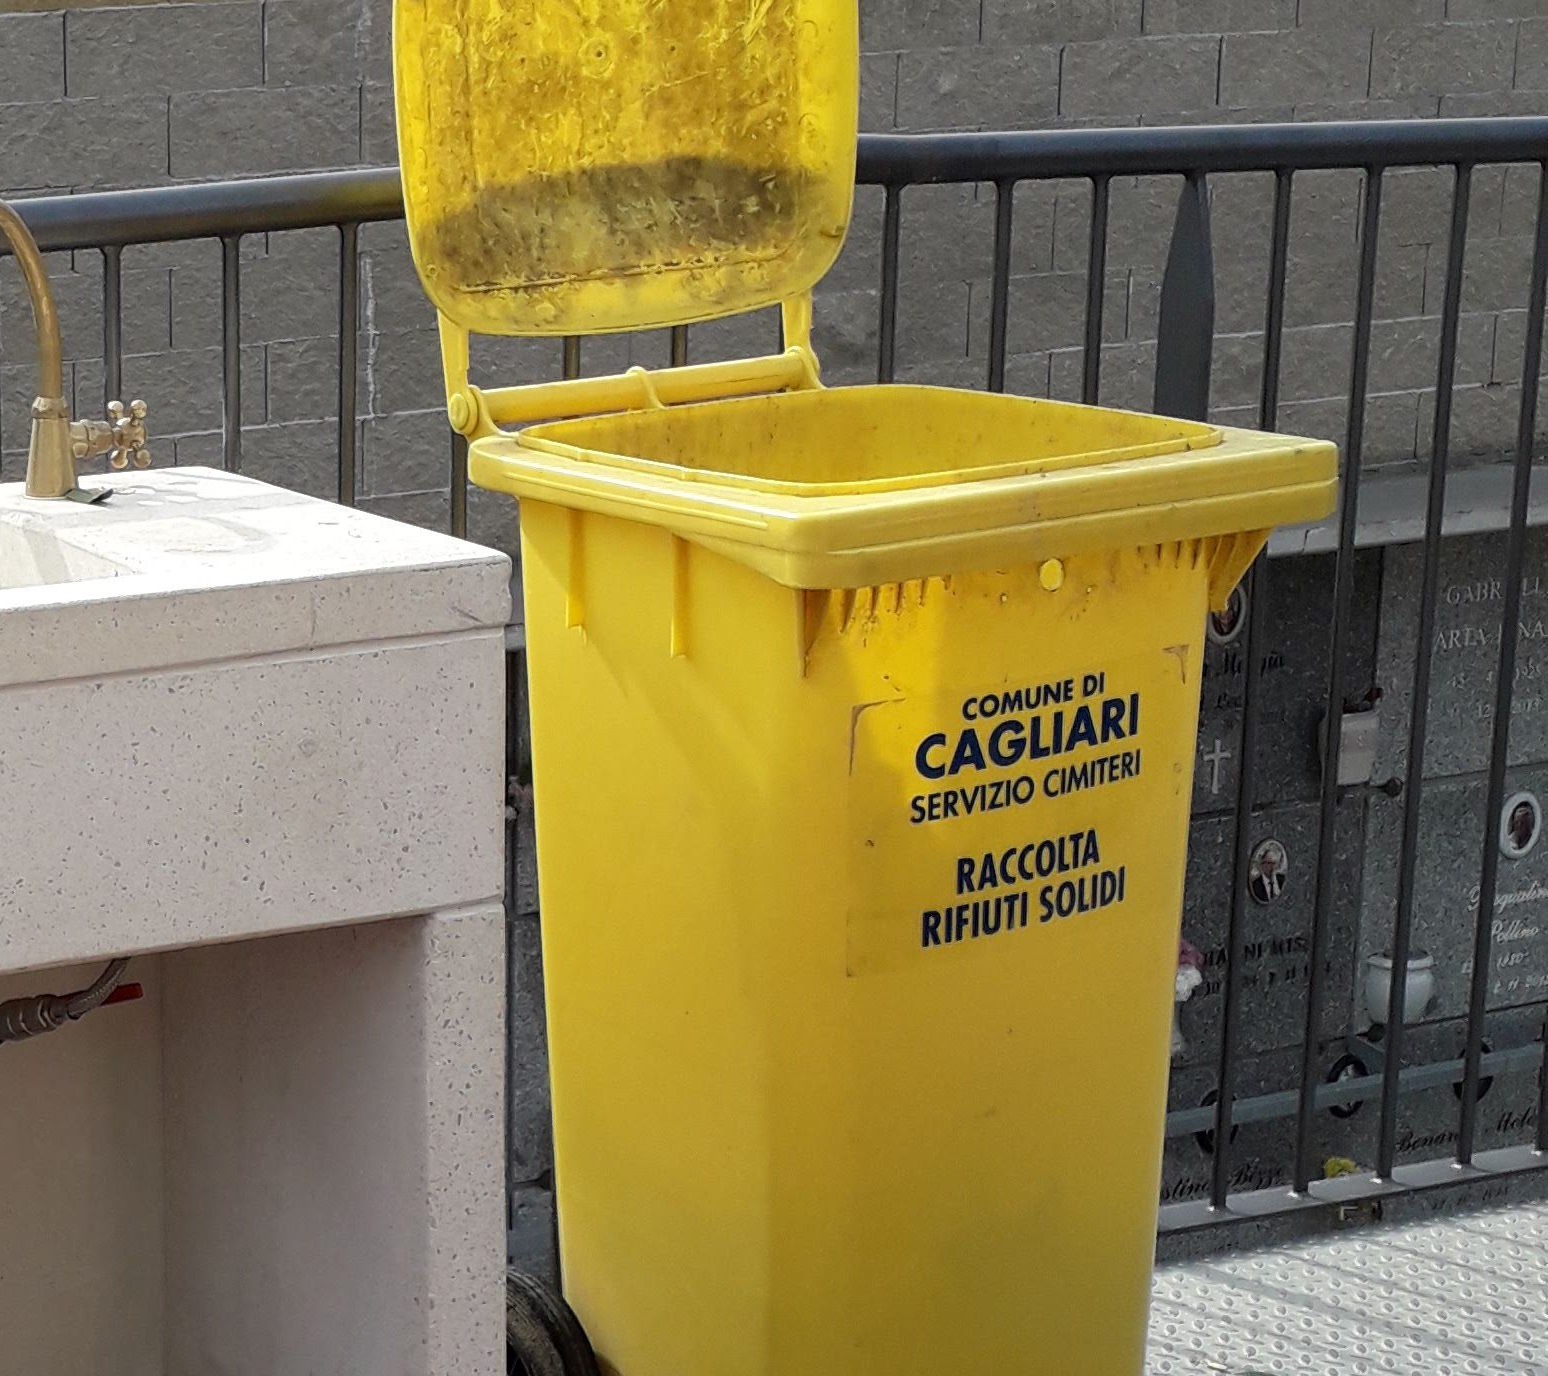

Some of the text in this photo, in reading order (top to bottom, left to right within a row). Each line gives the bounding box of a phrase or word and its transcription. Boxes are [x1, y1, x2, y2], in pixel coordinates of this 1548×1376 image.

[962, 671, 1105, 721] COMUNE DI
[915, 692, 1140, 779] CAGLIARI
[909, 748, 1142, 824] SERVIZIO CIMITERI
[956, 829, 1100, 895] RACCOLTA
[922, 866, 1126, 948] RIFIUTI SOLIDI
